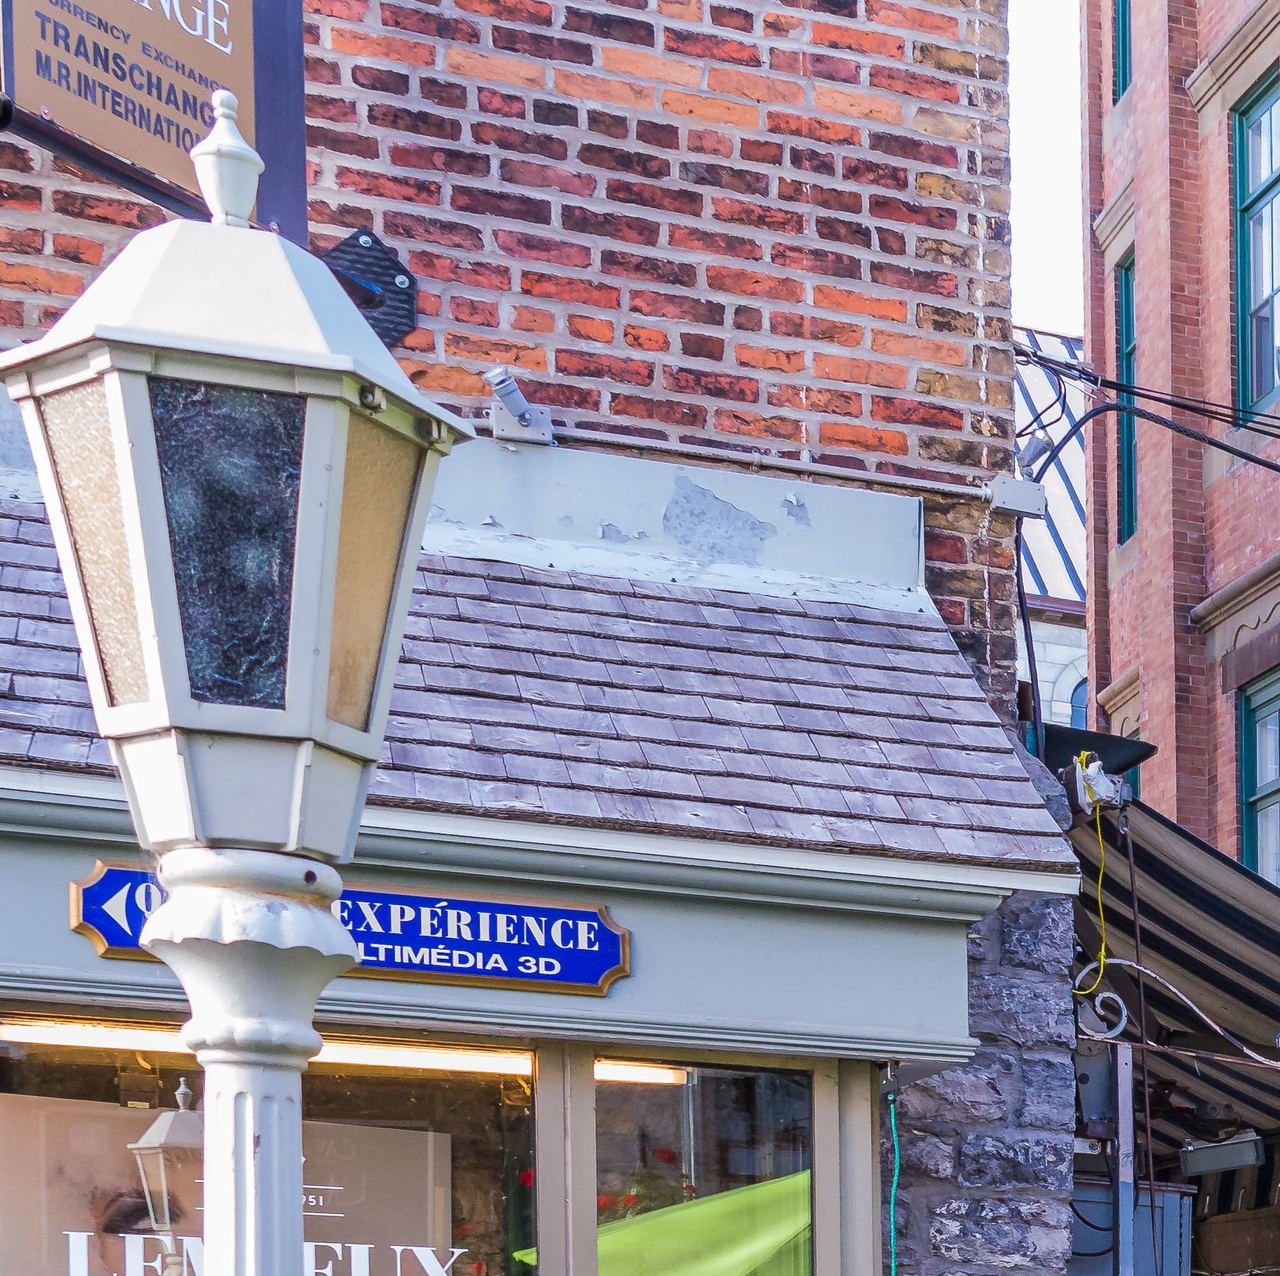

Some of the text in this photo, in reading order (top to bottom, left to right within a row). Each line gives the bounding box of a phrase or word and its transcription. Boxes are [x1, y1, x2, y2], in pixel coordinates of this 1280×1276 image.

[141, 41, 230, 92] EXCHANG
[331, 899, 599, 951] EXPÉRIENCE
[518, 957, 561, 975] 3D
